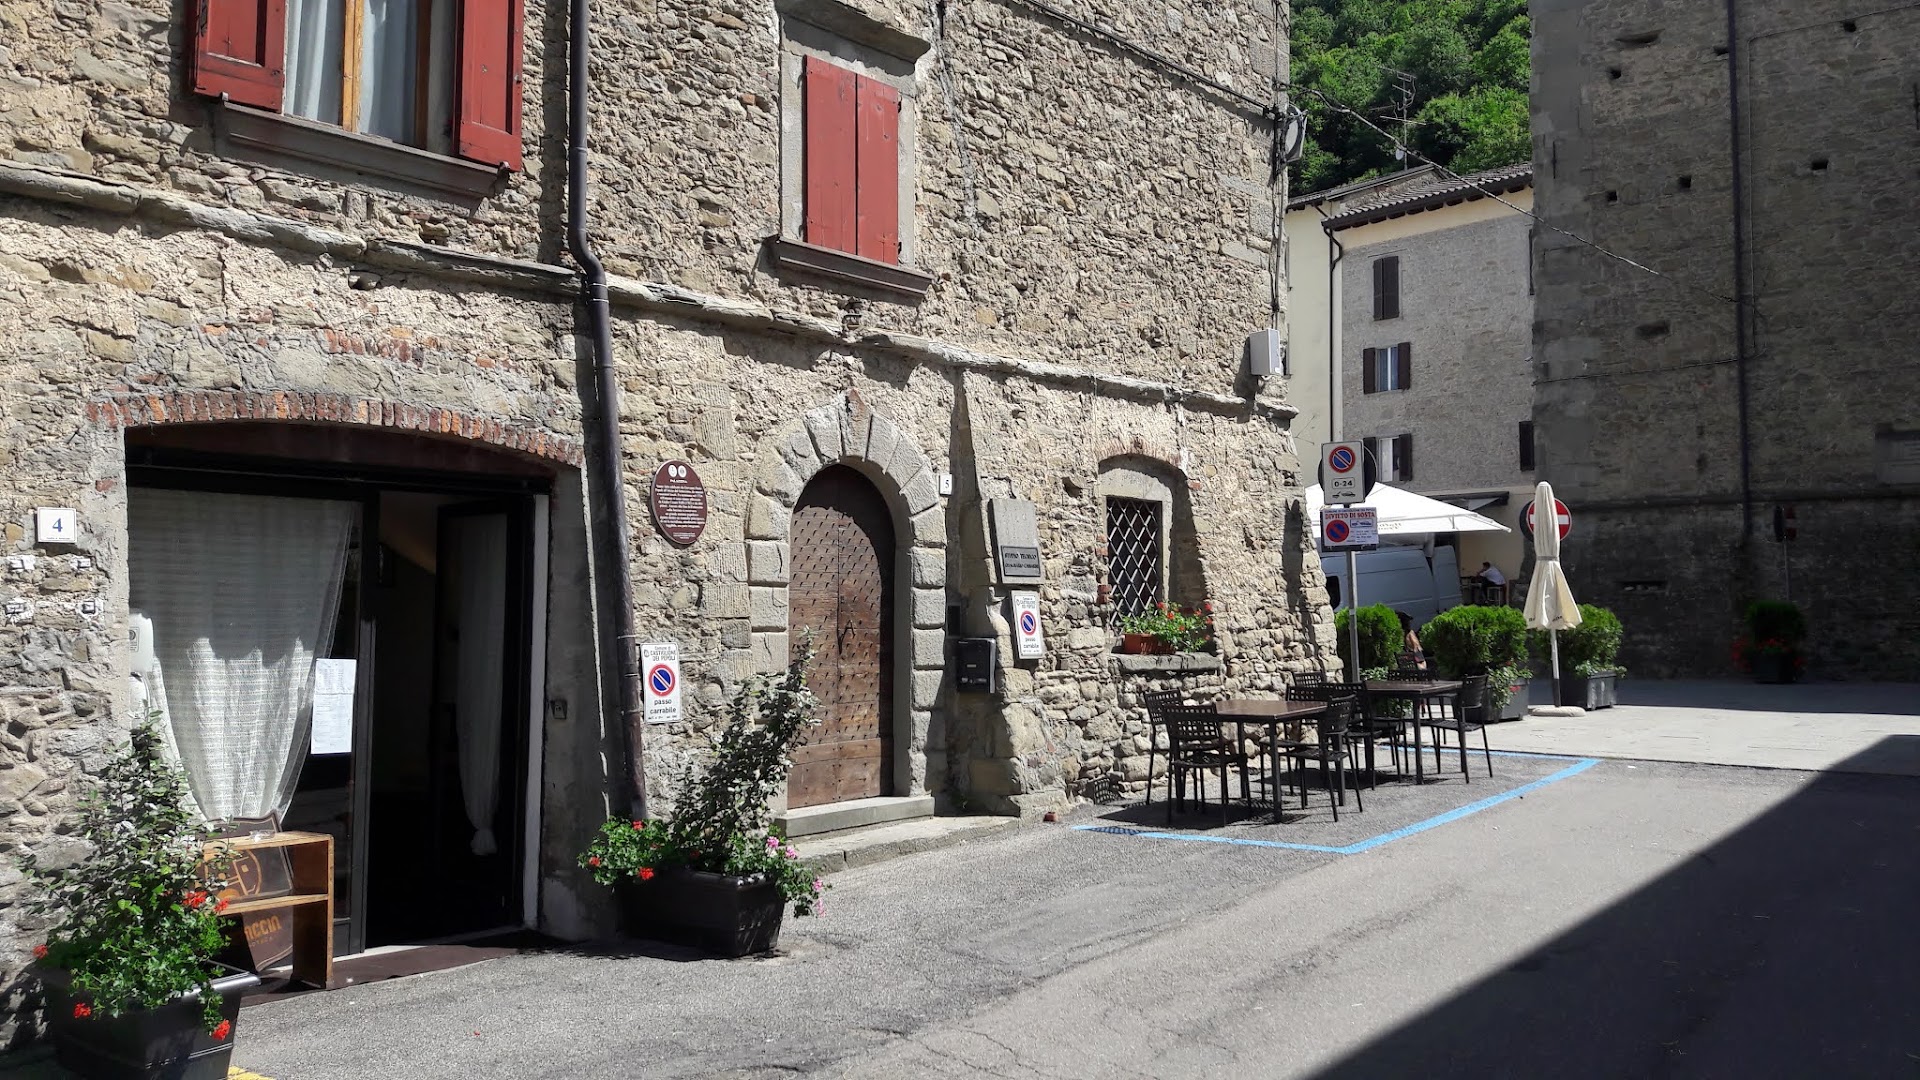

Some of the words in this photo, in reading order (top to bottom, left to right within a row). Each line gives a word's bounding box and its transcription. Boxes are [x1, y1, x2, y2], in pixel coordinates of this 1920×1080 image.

[945, 479, 950, 489] 5
[1325, 512, 1348, 520] DIVIETO
[52, 517, 63, 533] 4
[649, 706, 677, 714] carrabile
